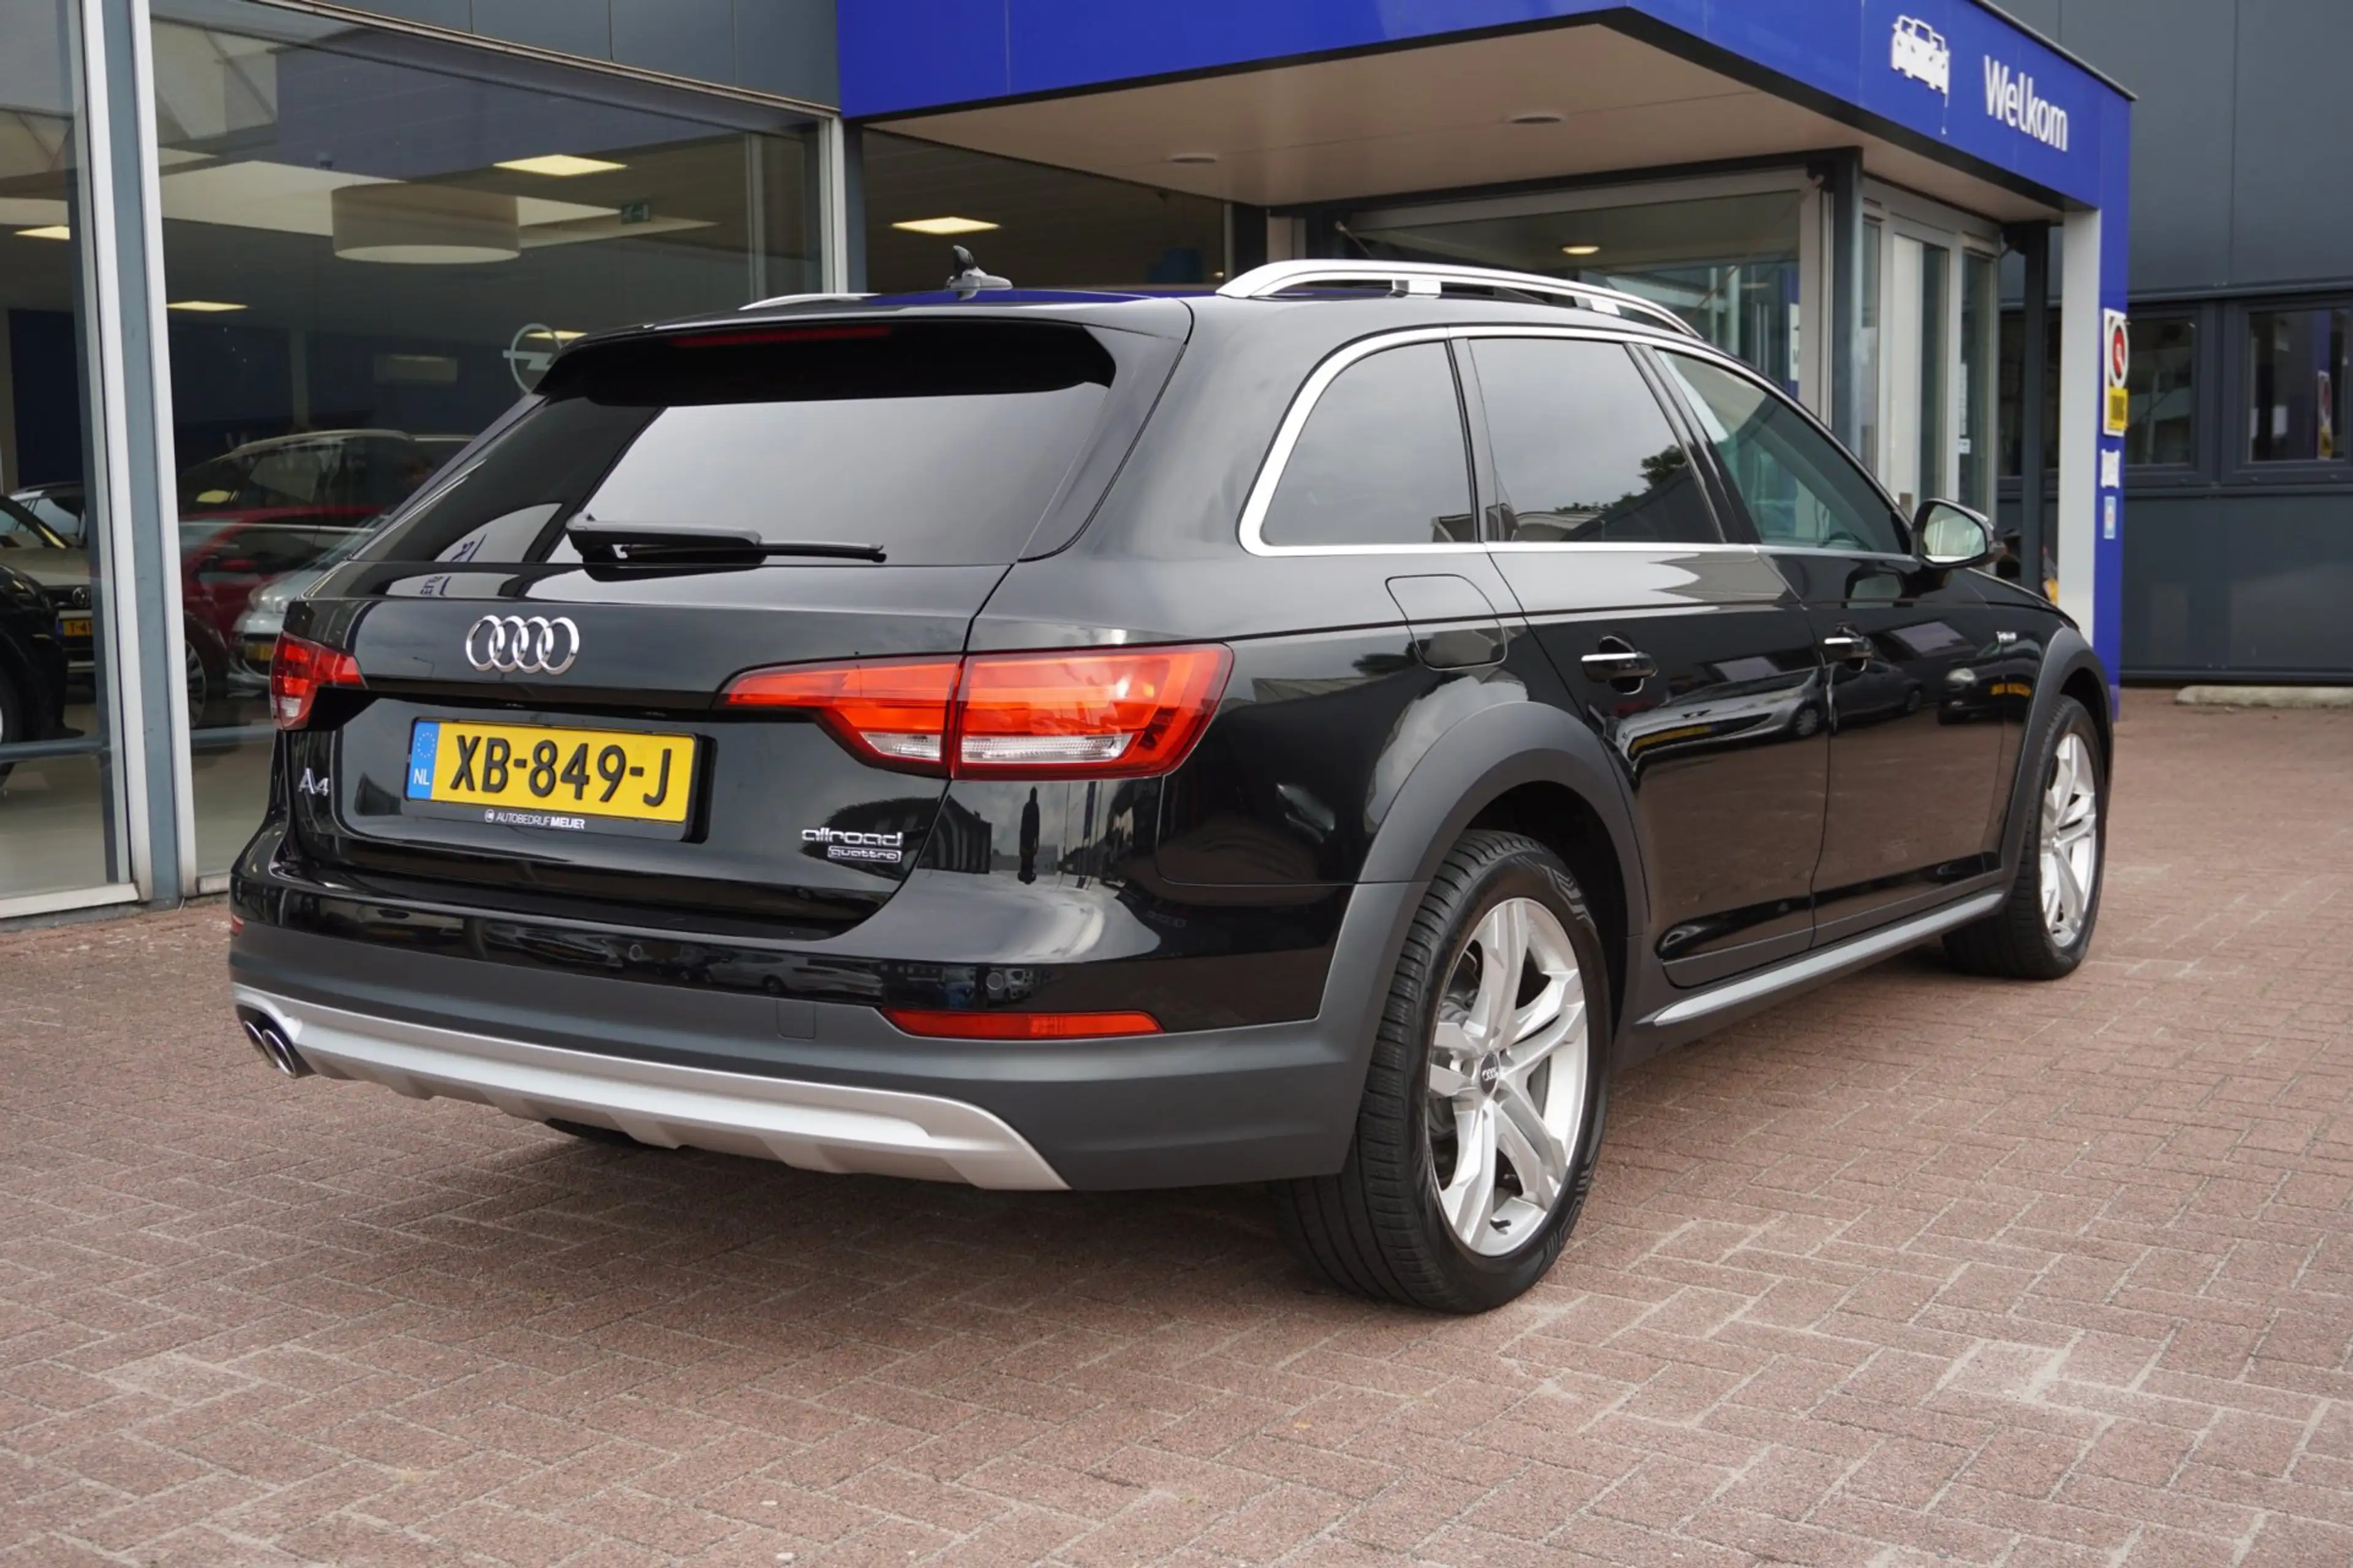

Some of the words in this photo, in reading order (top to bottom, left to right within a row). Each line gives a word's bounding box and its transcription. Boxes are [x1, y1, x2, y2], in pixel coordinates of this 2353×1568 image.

[1984, 55, 2067, 151] Welkom
[298, 767, 328, 796] A4
[413, 768, 430, 785] NL
[449, 735, 672, 807] XB-849-J
[801, 827, 903, 847] allroad
[830, 848, 897, 860] quattro
